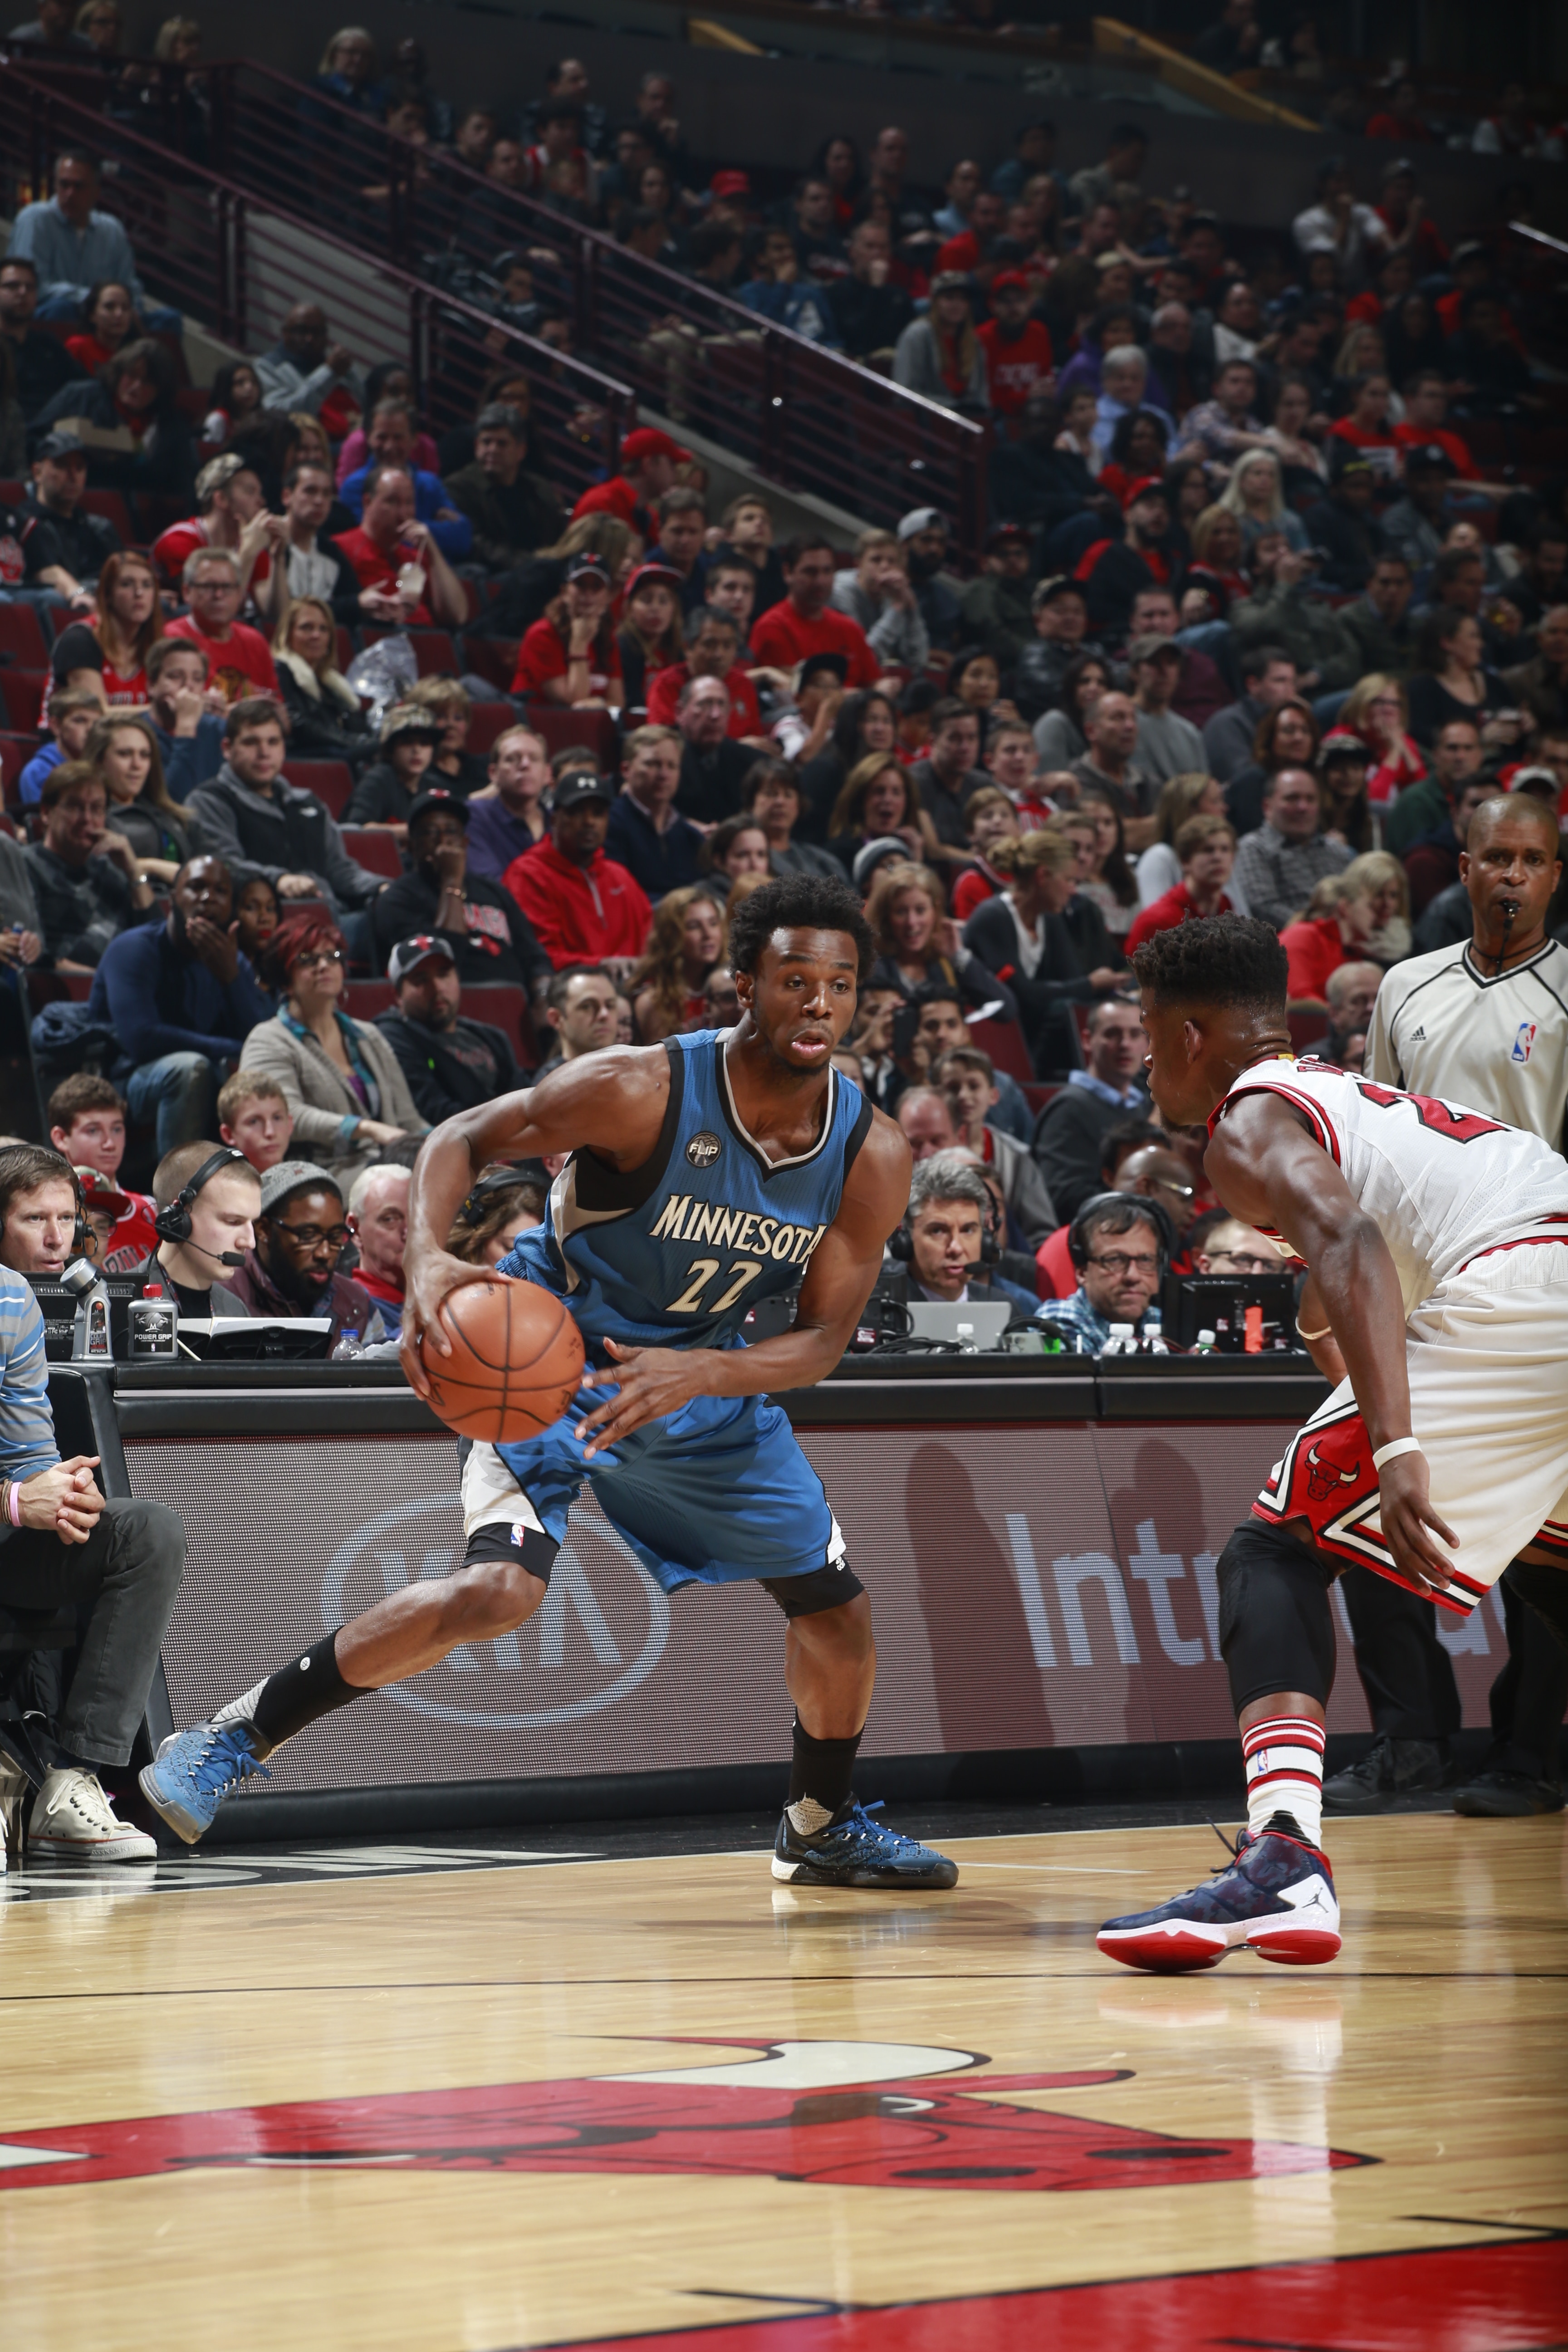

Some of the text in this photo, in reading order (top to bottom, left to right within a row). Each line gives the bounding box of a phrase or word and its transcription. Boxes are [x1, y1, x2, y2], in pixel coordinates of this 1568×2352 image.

[1513, 1053, 1523, 1061] NBA
[689, 1143, 718, 1156] FLIP
[647, 1194, 828, 1264] MINNESOTA
[663, 1258, 763, 1313] 22
